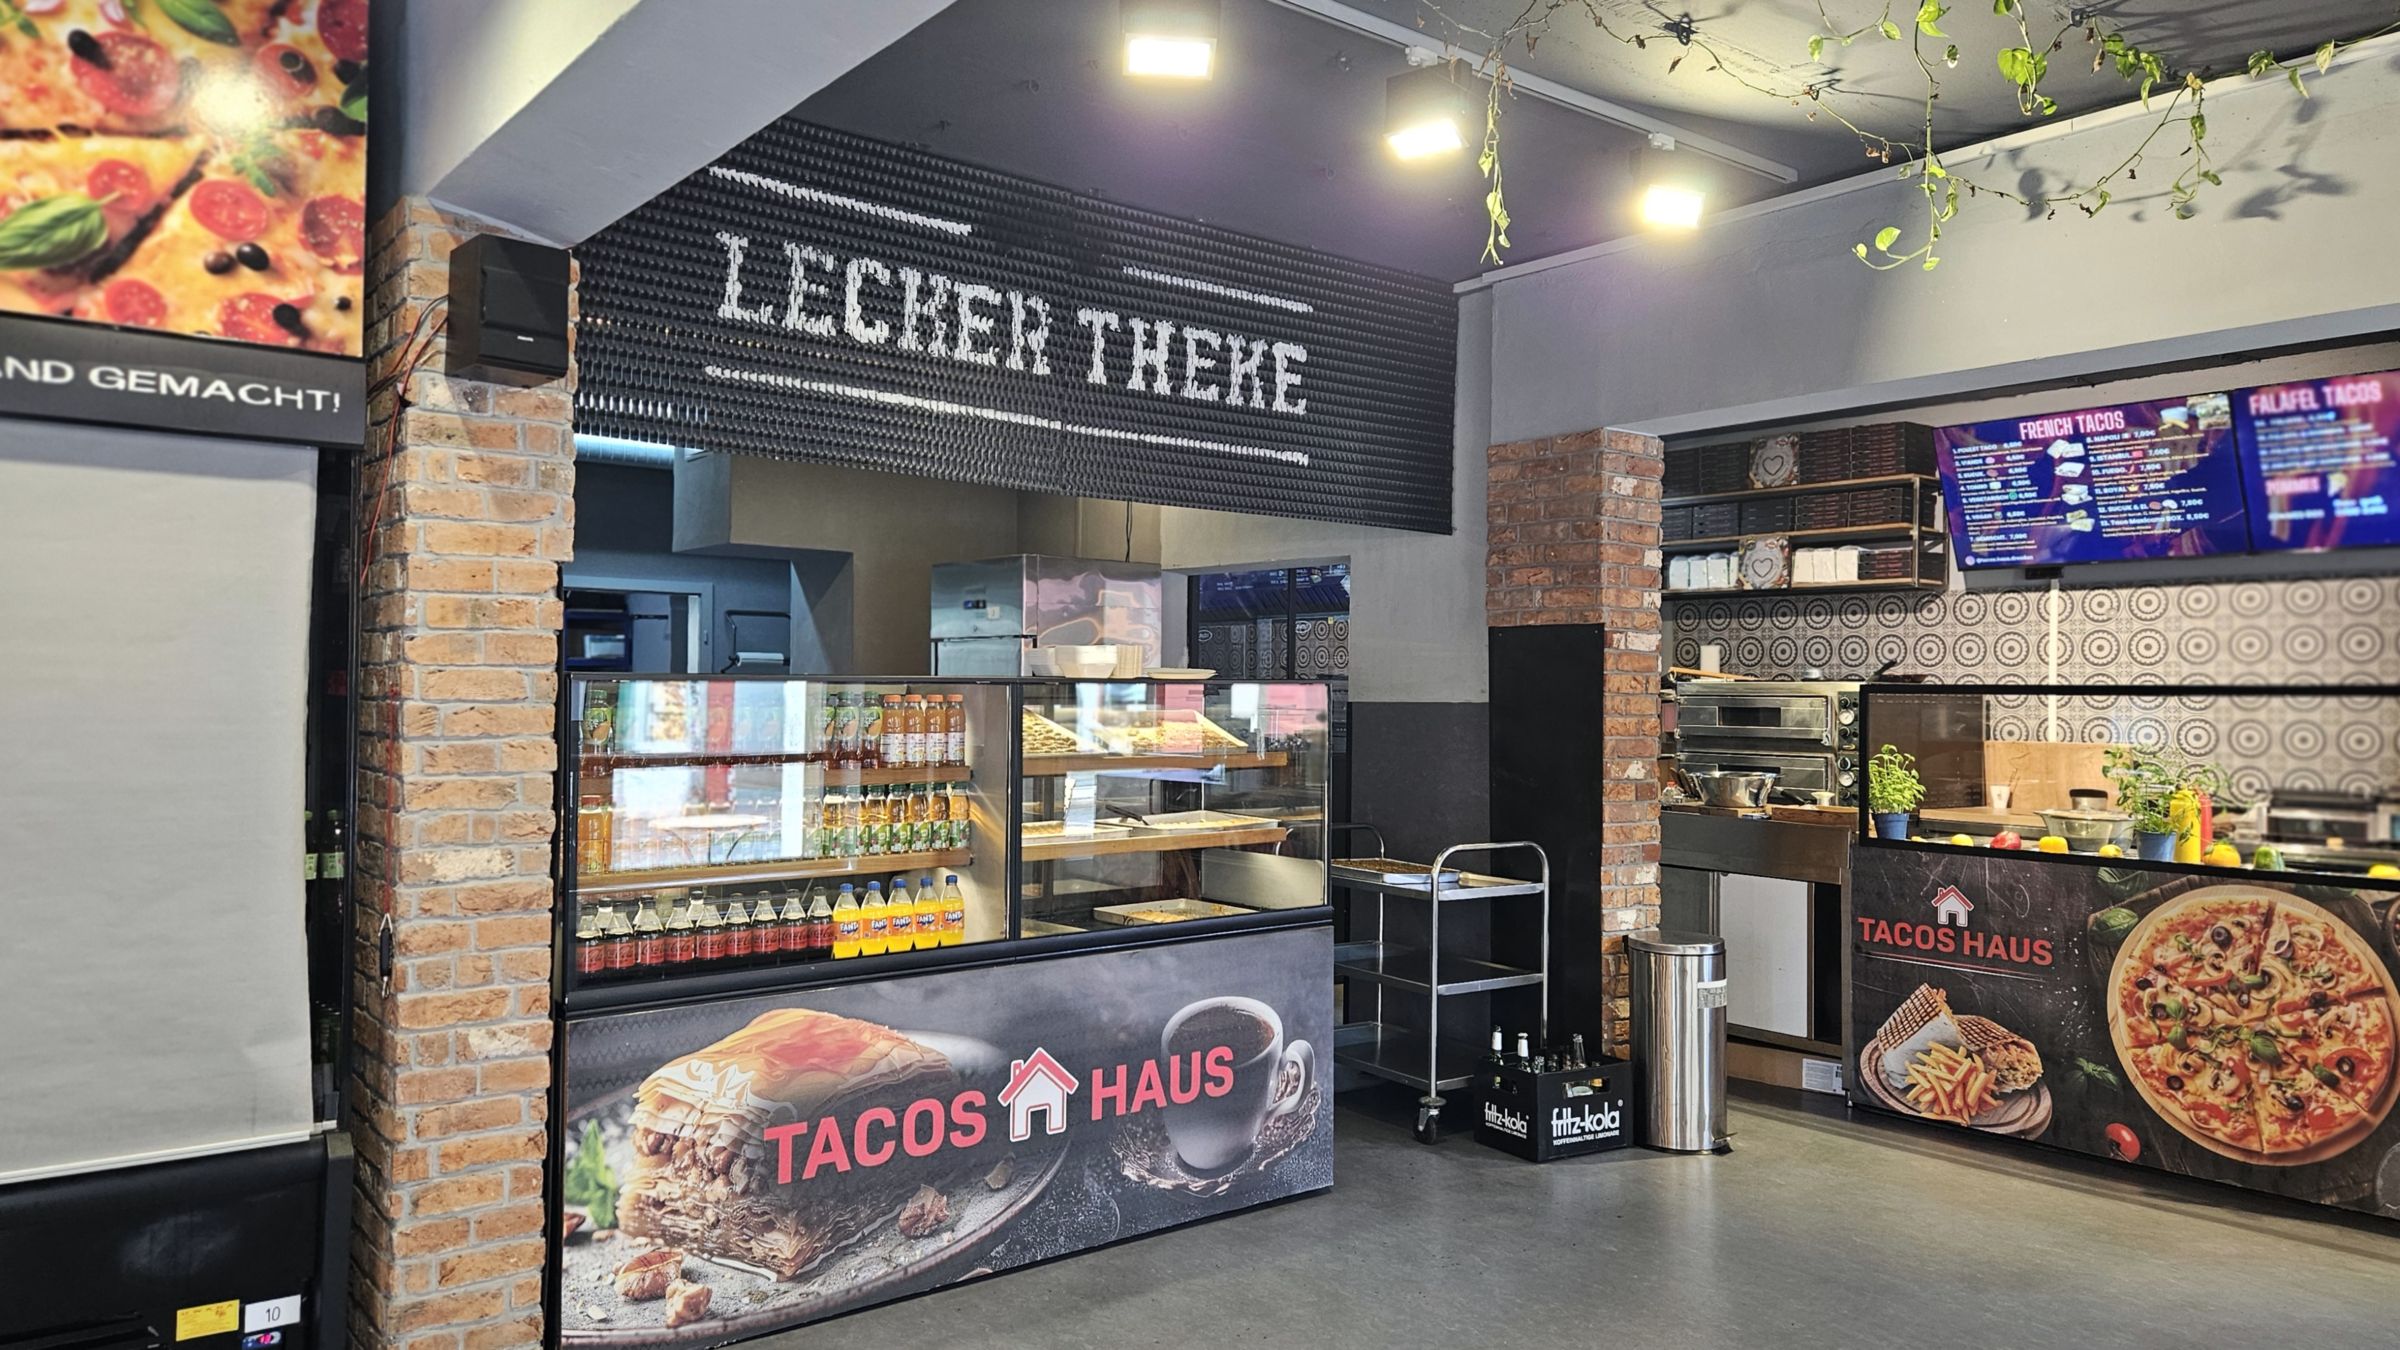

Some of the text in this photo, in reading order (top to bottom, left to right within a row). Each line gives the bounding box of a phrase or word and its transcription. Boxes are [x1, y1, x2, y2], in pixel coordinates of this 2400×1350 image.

[714, 231, 1307, 415] LECKER THEKE
[0, 356, 340, 412] ND GEMACHT!
[2249, 380, 2382, 415] FALAFEL TACOS
[2019, 410, 2125, 440] FRENCH TACOS
[1857, 917, 2053, 966] TACOS HAUS
[763, 1046, 1235, 1185] TACOS HAUS
[1484, 1101, 1527, 1134] fritz-kola
[1551, 1101, 1620, 1137] fritz-kola
[1595, 1129, 1620, 1139] LIMONADE
[265, 1306, 281, 1322] 10
